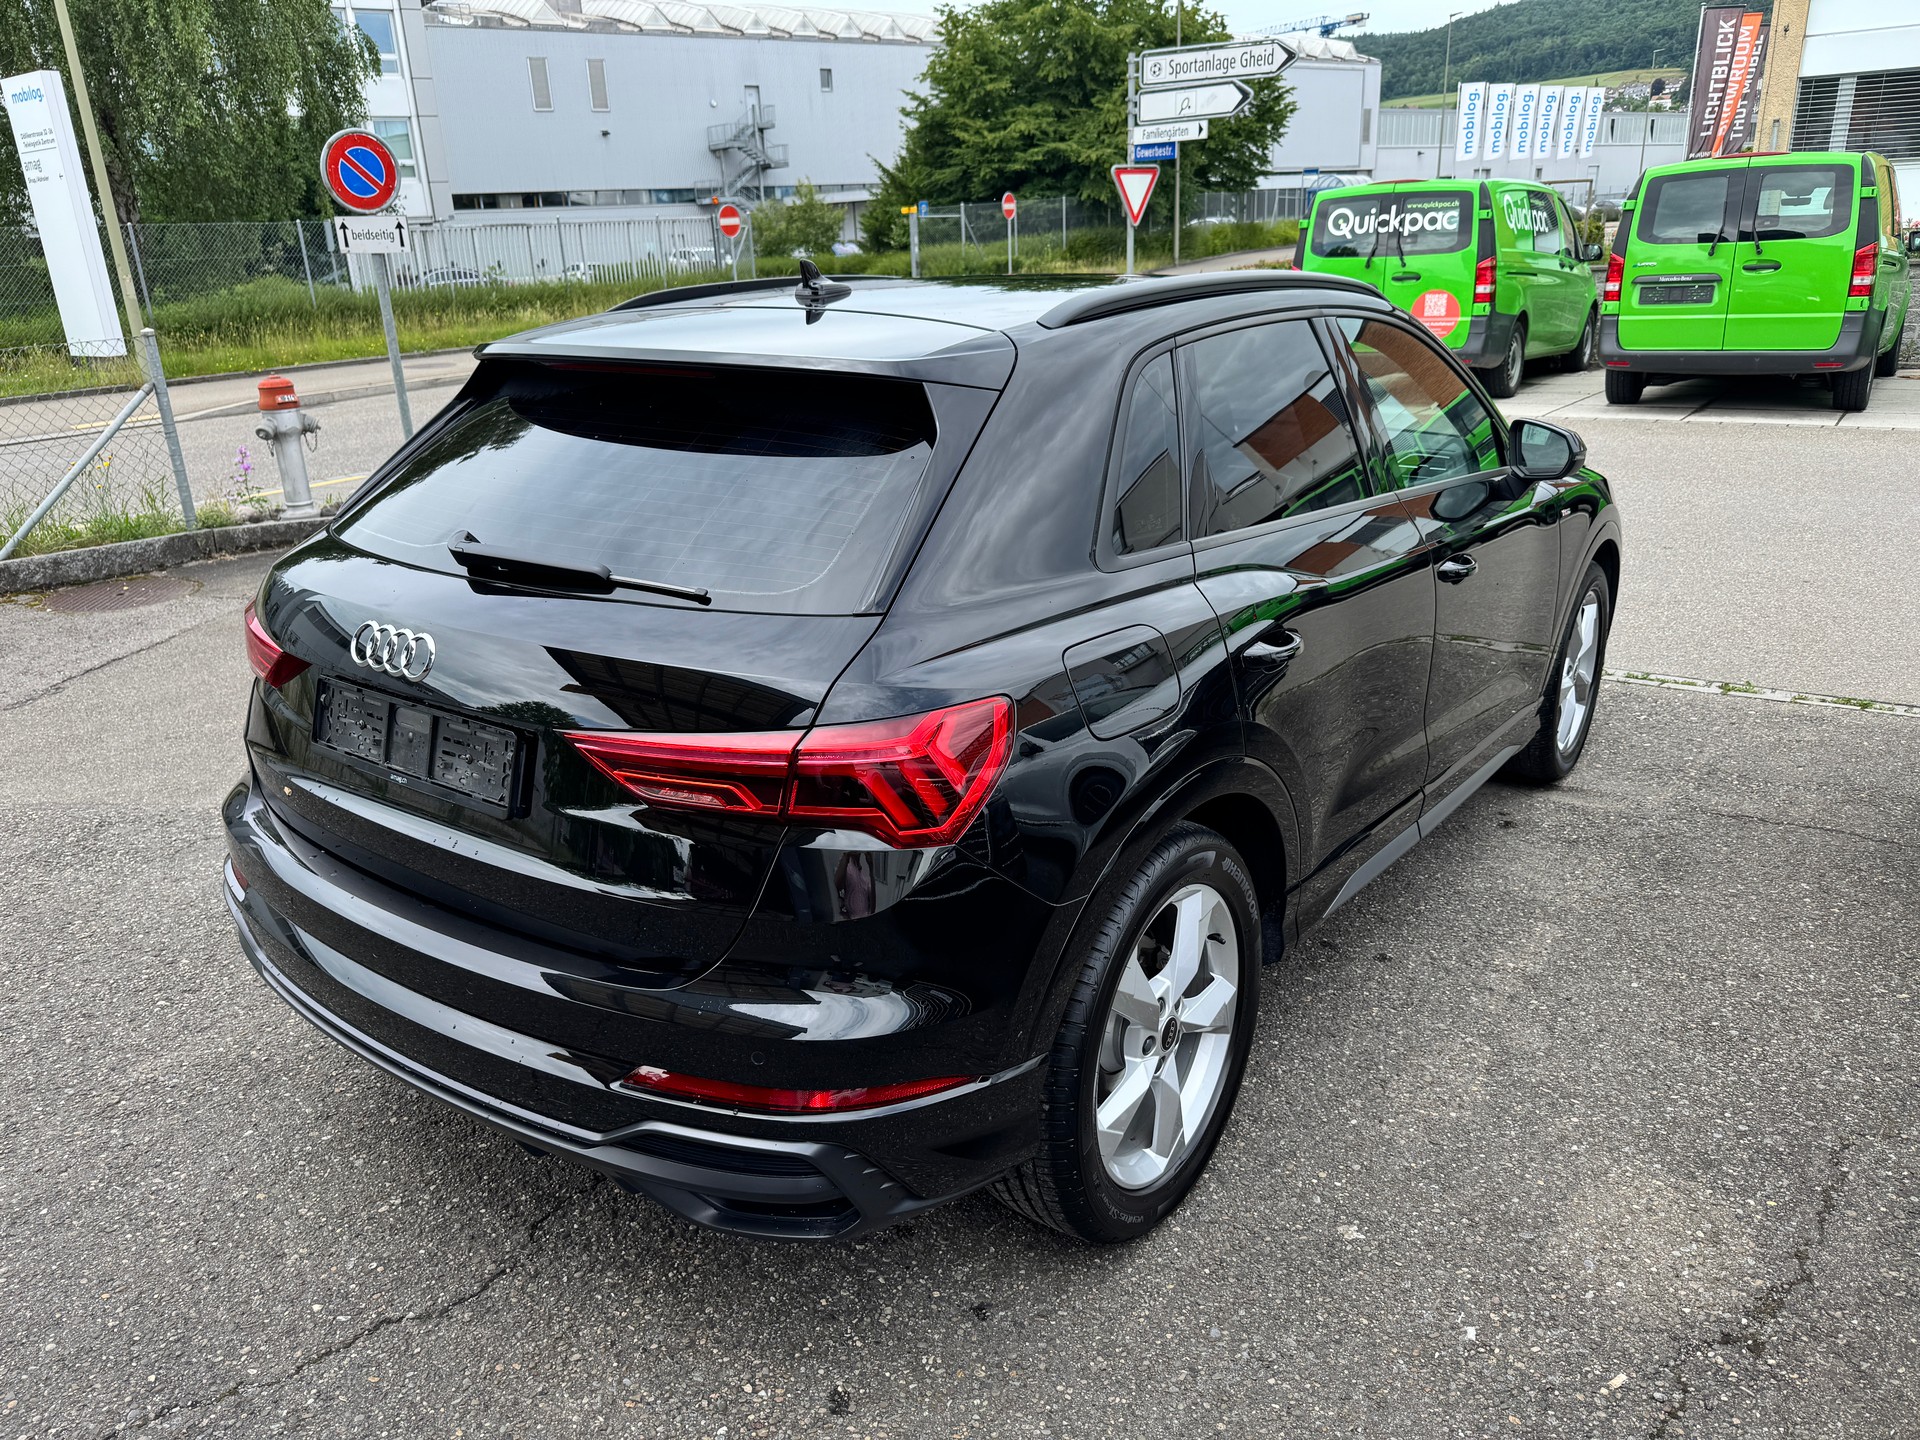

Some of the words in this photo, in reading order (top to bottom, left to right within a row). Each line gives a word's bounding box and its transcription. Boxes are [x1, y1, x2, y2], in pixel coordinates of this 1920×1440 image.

[1169, 54, 1236, 79] Sportanlage
[1240, 48, 1275, 68] Gheid
[1700, 18, 1737, 137] LICHTBLICK
[11, 86, 44, 104] mobilog.
[1730, 98, 1748, 141] THUT
[1136, 144, 1174, 158] Gewerbestr.
[24, 159, 43, 173] amag
[1407, 200, 1460, 209] www.quickpac.ch
[1503, 193, 1549, 236] Quickpac
[1328, 205, 1459, 239] Quickpac
[351, 228, 395, 243] beidseitig
